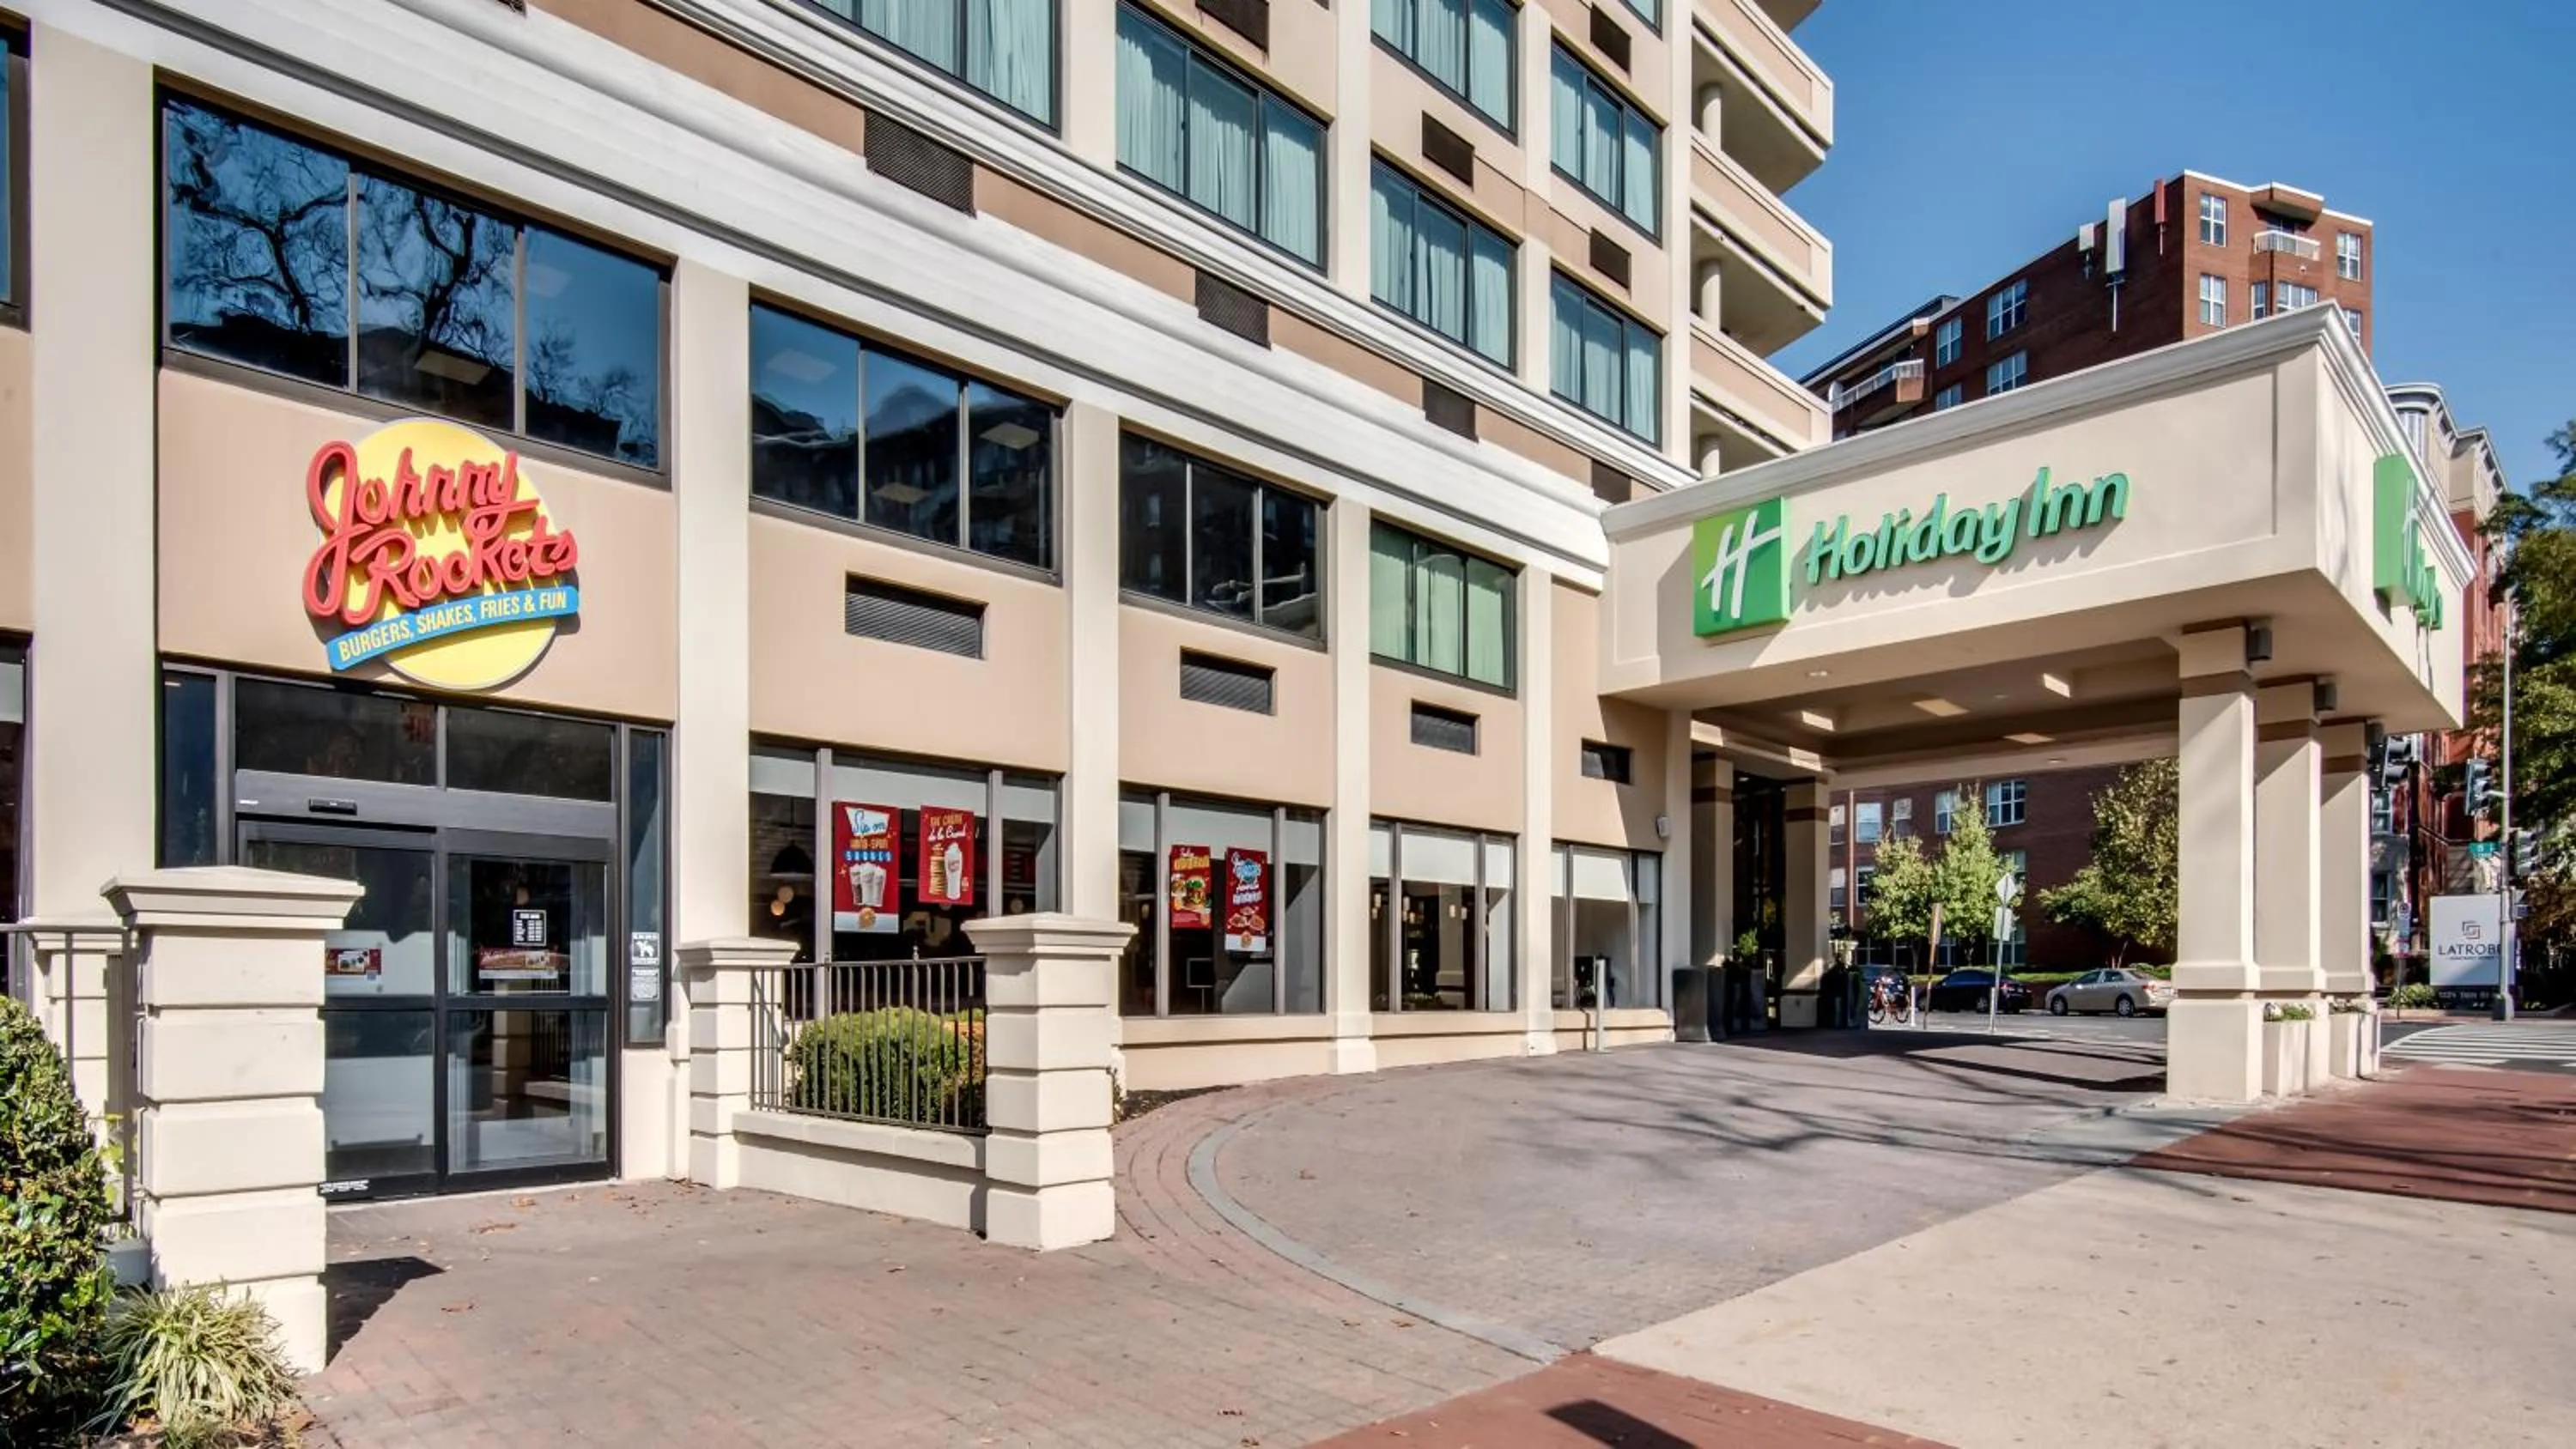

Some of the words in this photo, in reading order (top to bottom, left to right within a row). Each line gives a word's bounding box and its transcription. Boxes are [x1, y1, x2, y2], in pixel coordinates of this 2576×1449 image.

[302, 440, 541, 618] Johnny
[340, 515, 580, 627] Rockets
[1806, 493, 2021, 585] Holiday
[2027, 465, 2132, 537] Inn
[337, 618, 414, 662] BURGERS,
[415, 603, 477, 634] SHAKES,
[480, 596, 520, 620] FRIES
[523, 593, 536, 613] &
[539, 591, 567, 610] FUN
